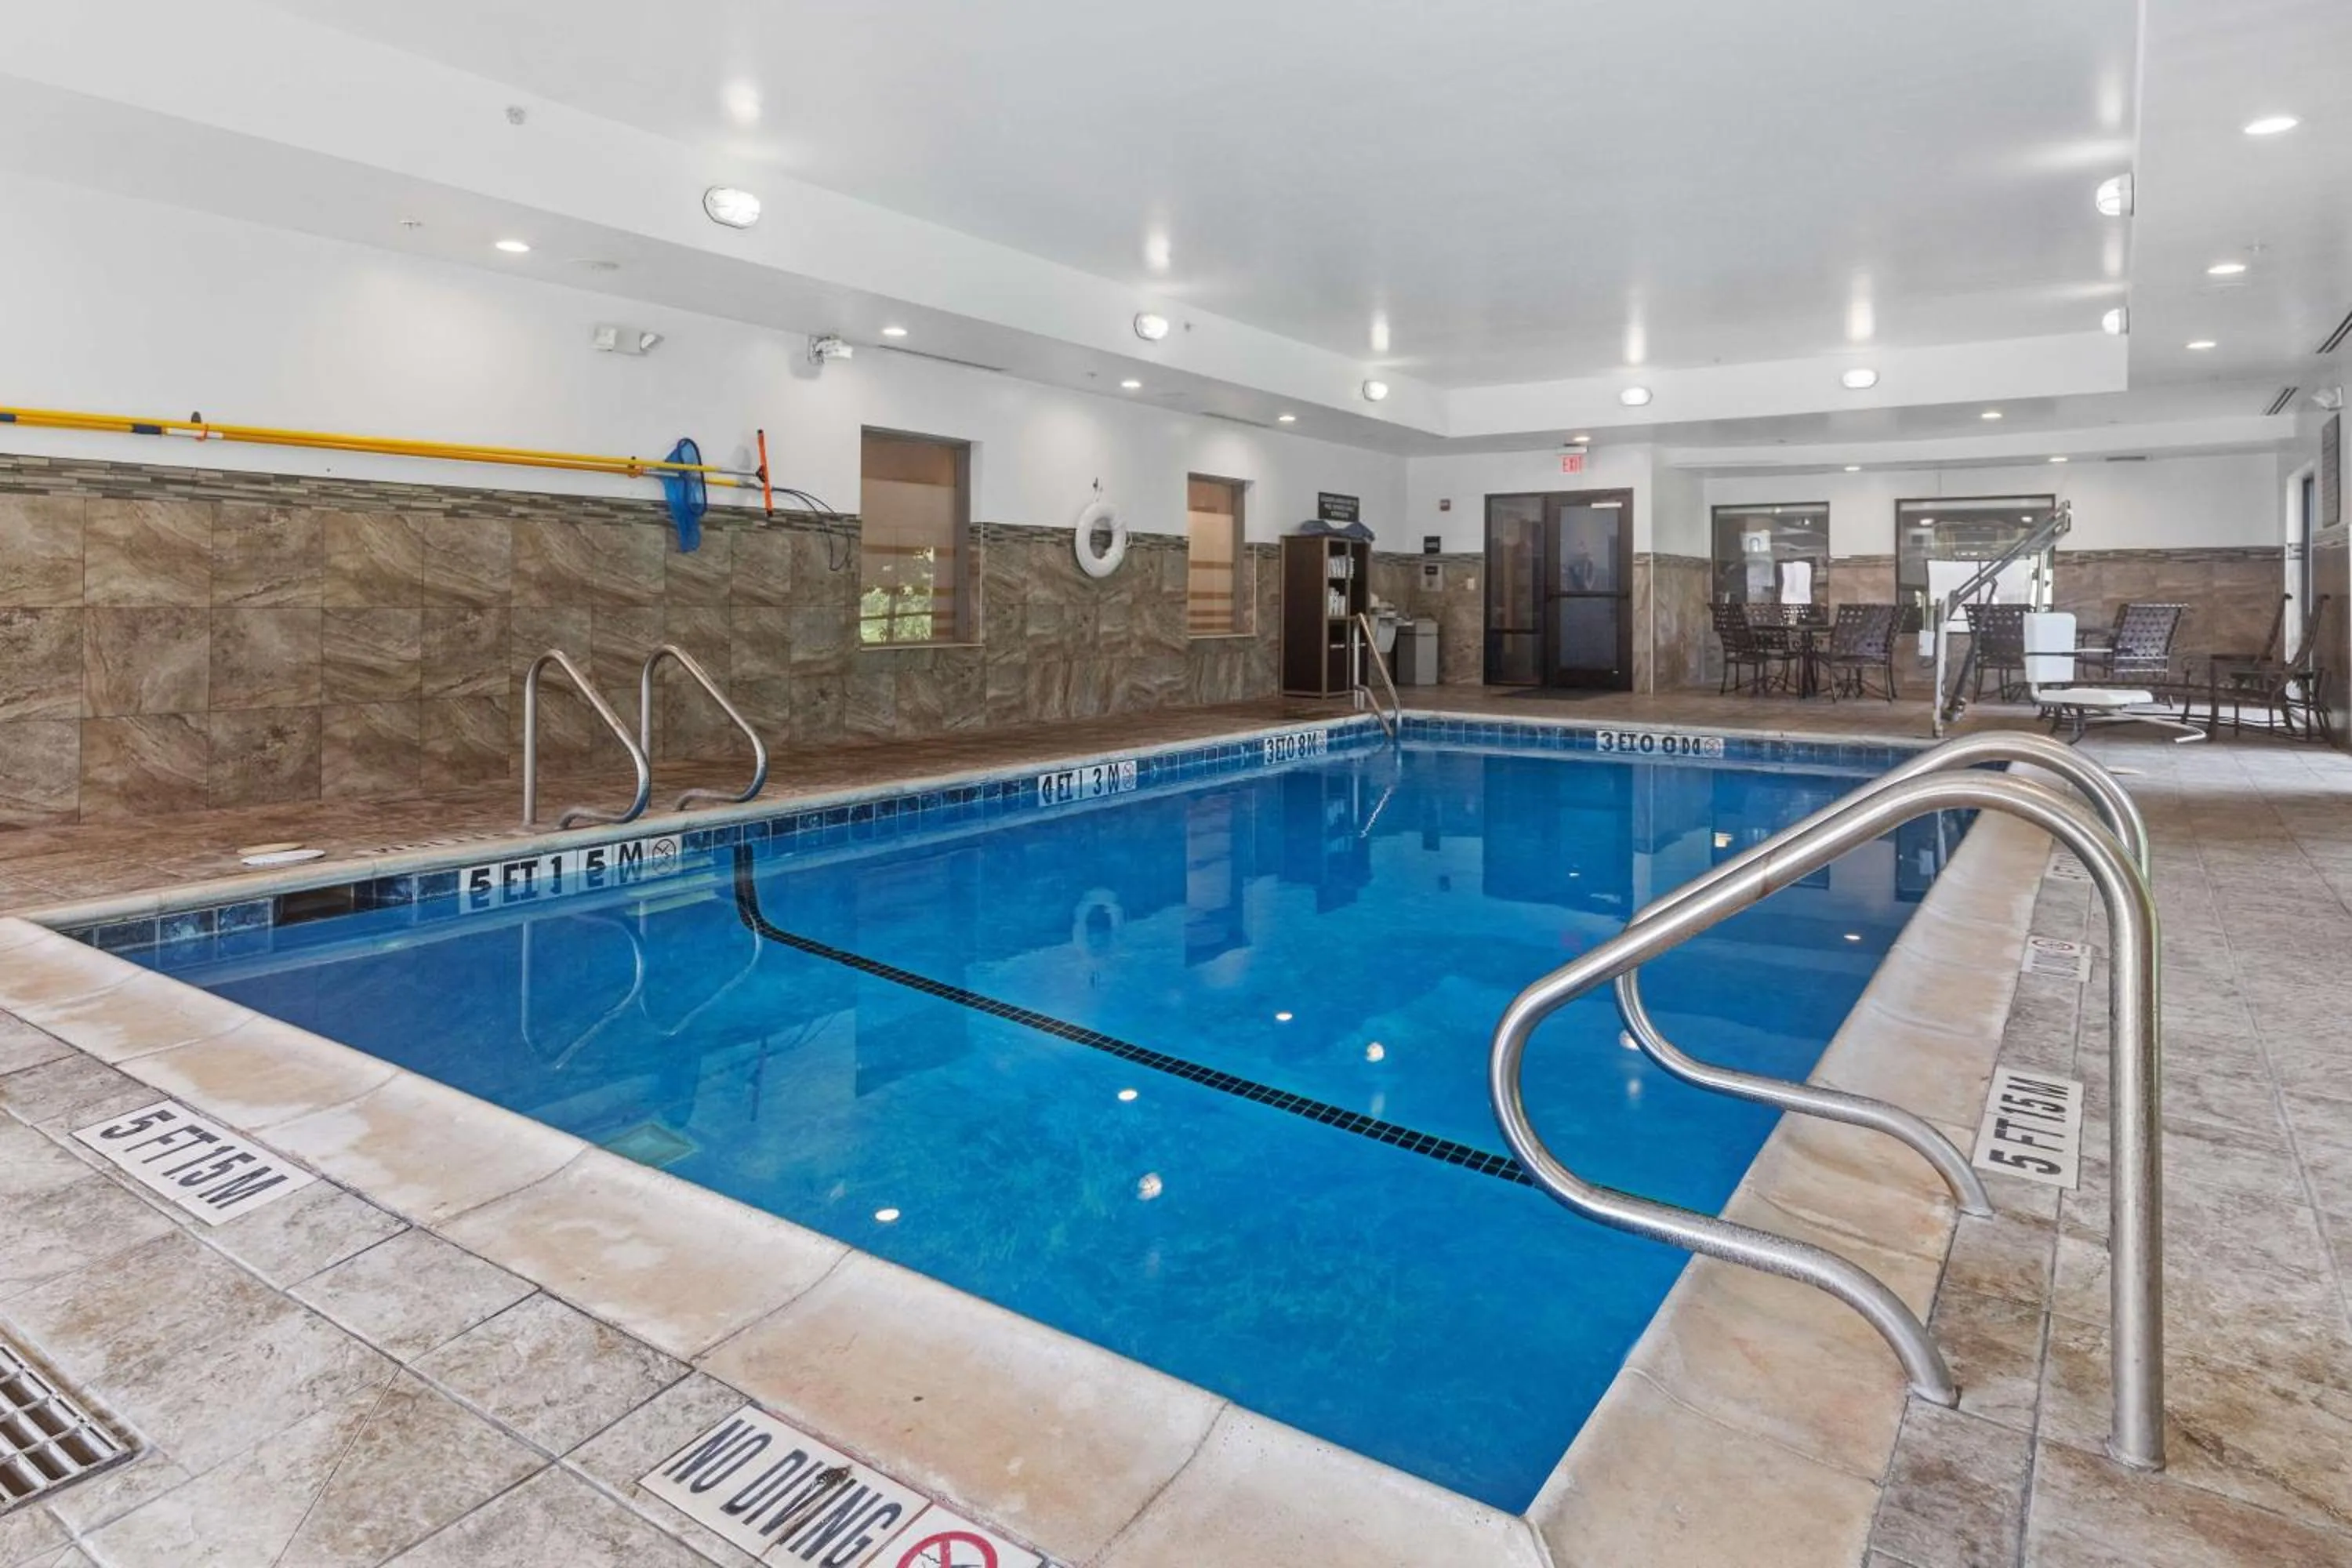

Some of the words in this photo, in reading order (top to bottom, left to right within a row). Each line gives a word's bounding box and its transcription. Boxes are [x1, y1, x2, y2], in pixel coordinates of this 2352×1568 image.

[100, 1109, 177, 1139] 5
[1989, 1149, 2062, 1175] 5
[662, 1418, 773, 1494] NO
[720, 1448, 903, 1568] DIVING
